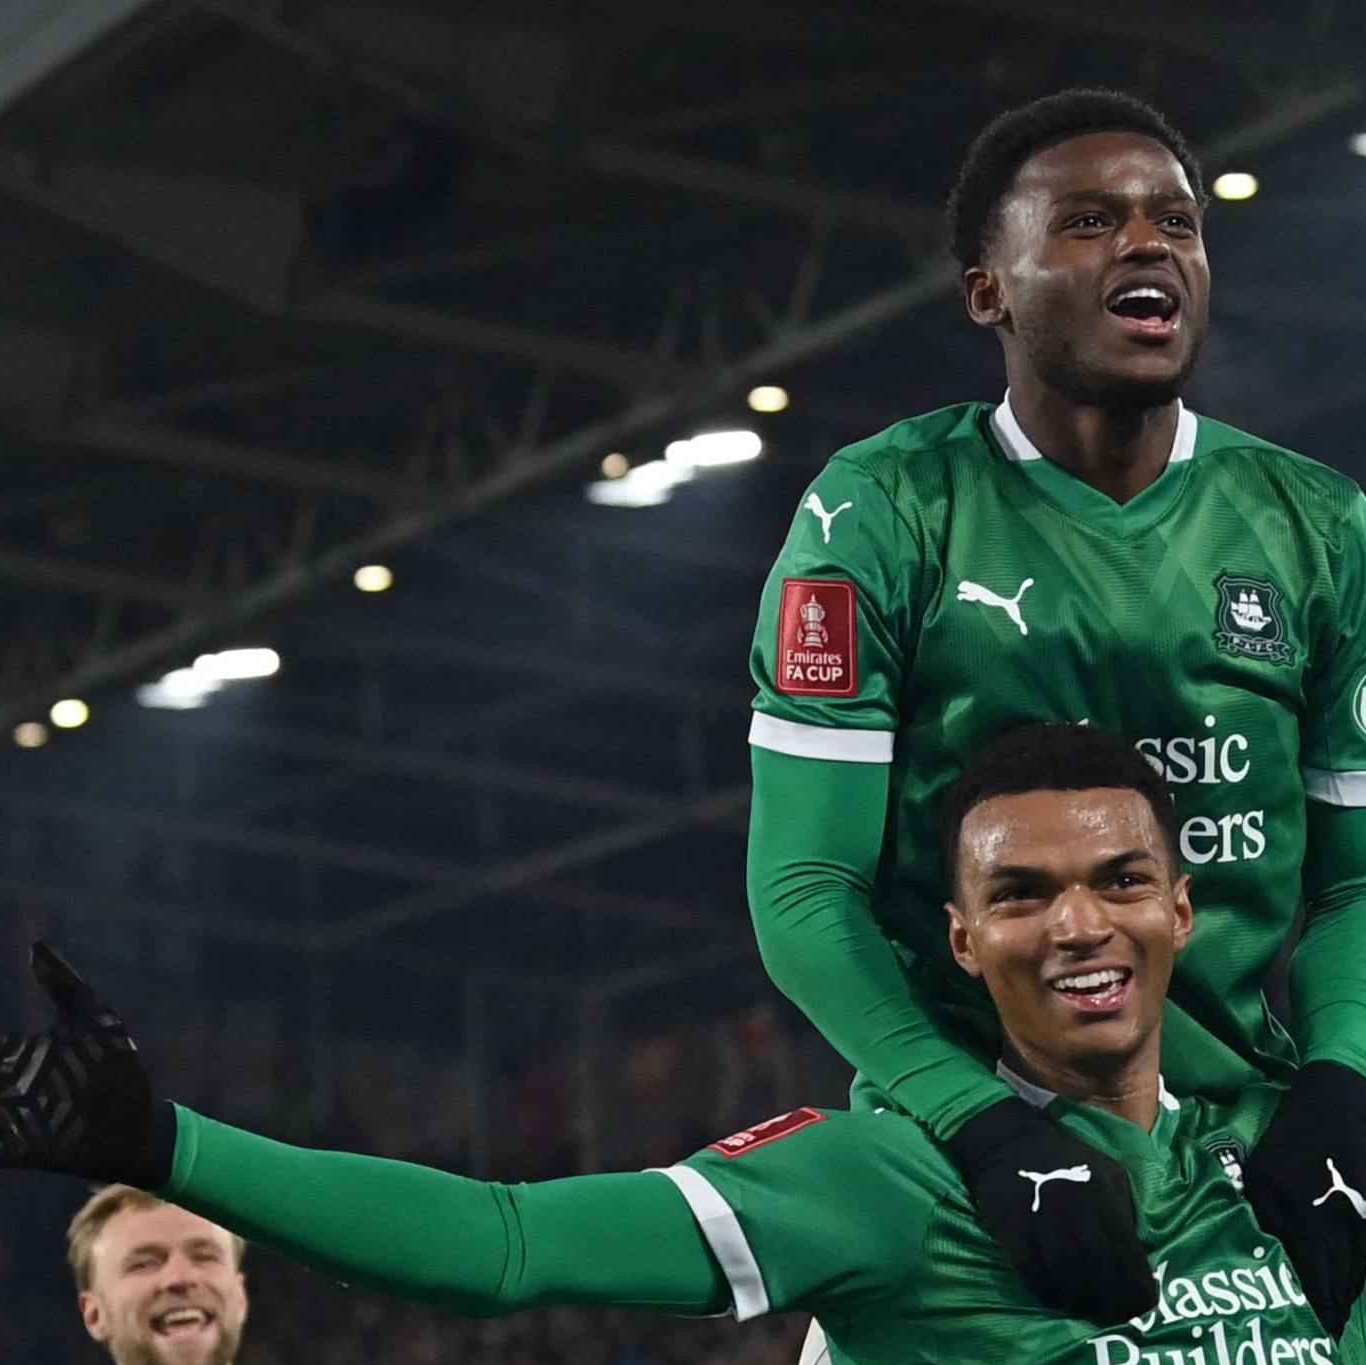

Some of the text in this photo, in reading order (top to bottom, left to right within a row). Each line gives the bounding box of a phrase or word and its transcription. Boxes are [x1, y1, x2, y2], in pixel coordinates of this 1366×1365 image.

[786, 649, 842, 666] Emirates
[786, 665, 843, 681] FA CUP
